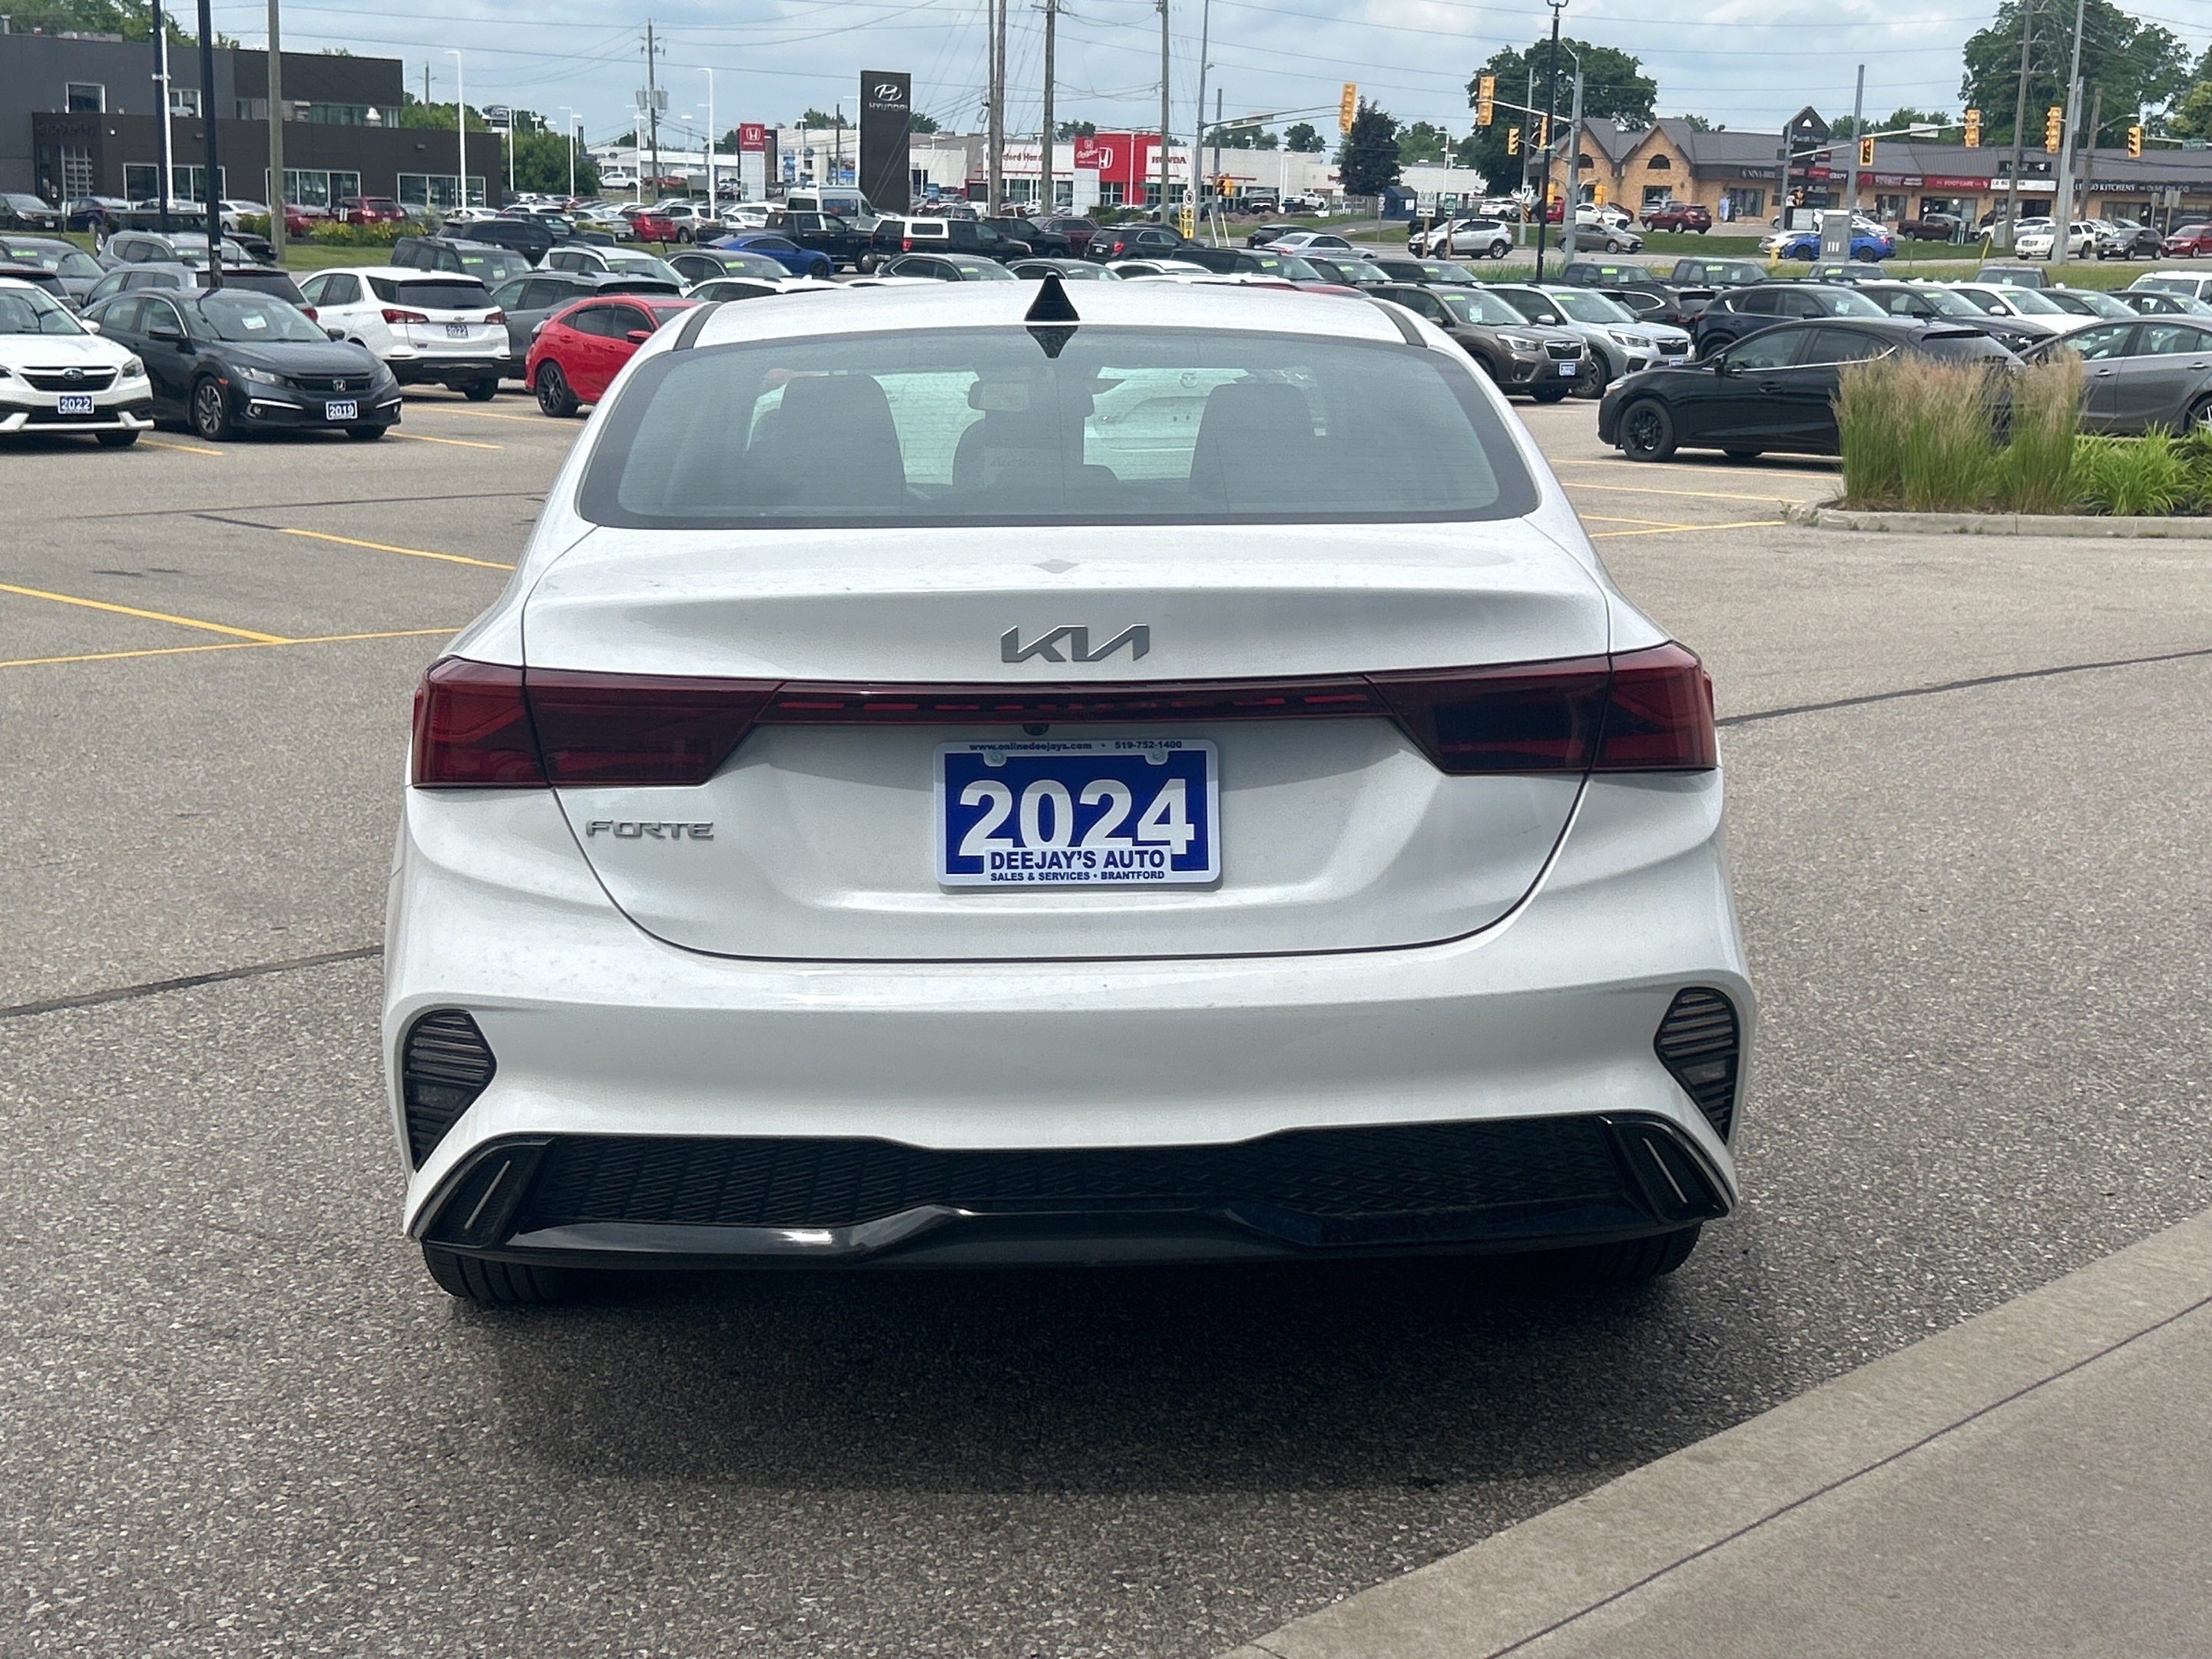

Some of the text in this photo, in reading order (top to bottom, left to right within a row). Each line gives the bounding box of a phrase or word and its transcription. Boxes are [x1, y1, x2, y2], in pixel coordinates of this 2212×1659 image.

[869, 101, 908, 111] HYUNDAI
[2099, 184, 2135, 192] KITCHENS
[61, 398, 91, 410] 2022
[329, 404, 354, 416] 2019
[1001, 623, 1150, 663] KIA
[969, 740, 1182, 751] www.onlinedeejays.com 519-752-1400
[958, 777, 1195, 856] 2024
[585, 820, 714, 841] FORTE
[990, 849, 1165, 869] DEEJAY'S AUTO
[990, 871, 1165, 881] SALES & SERVICES BRANTFORD
